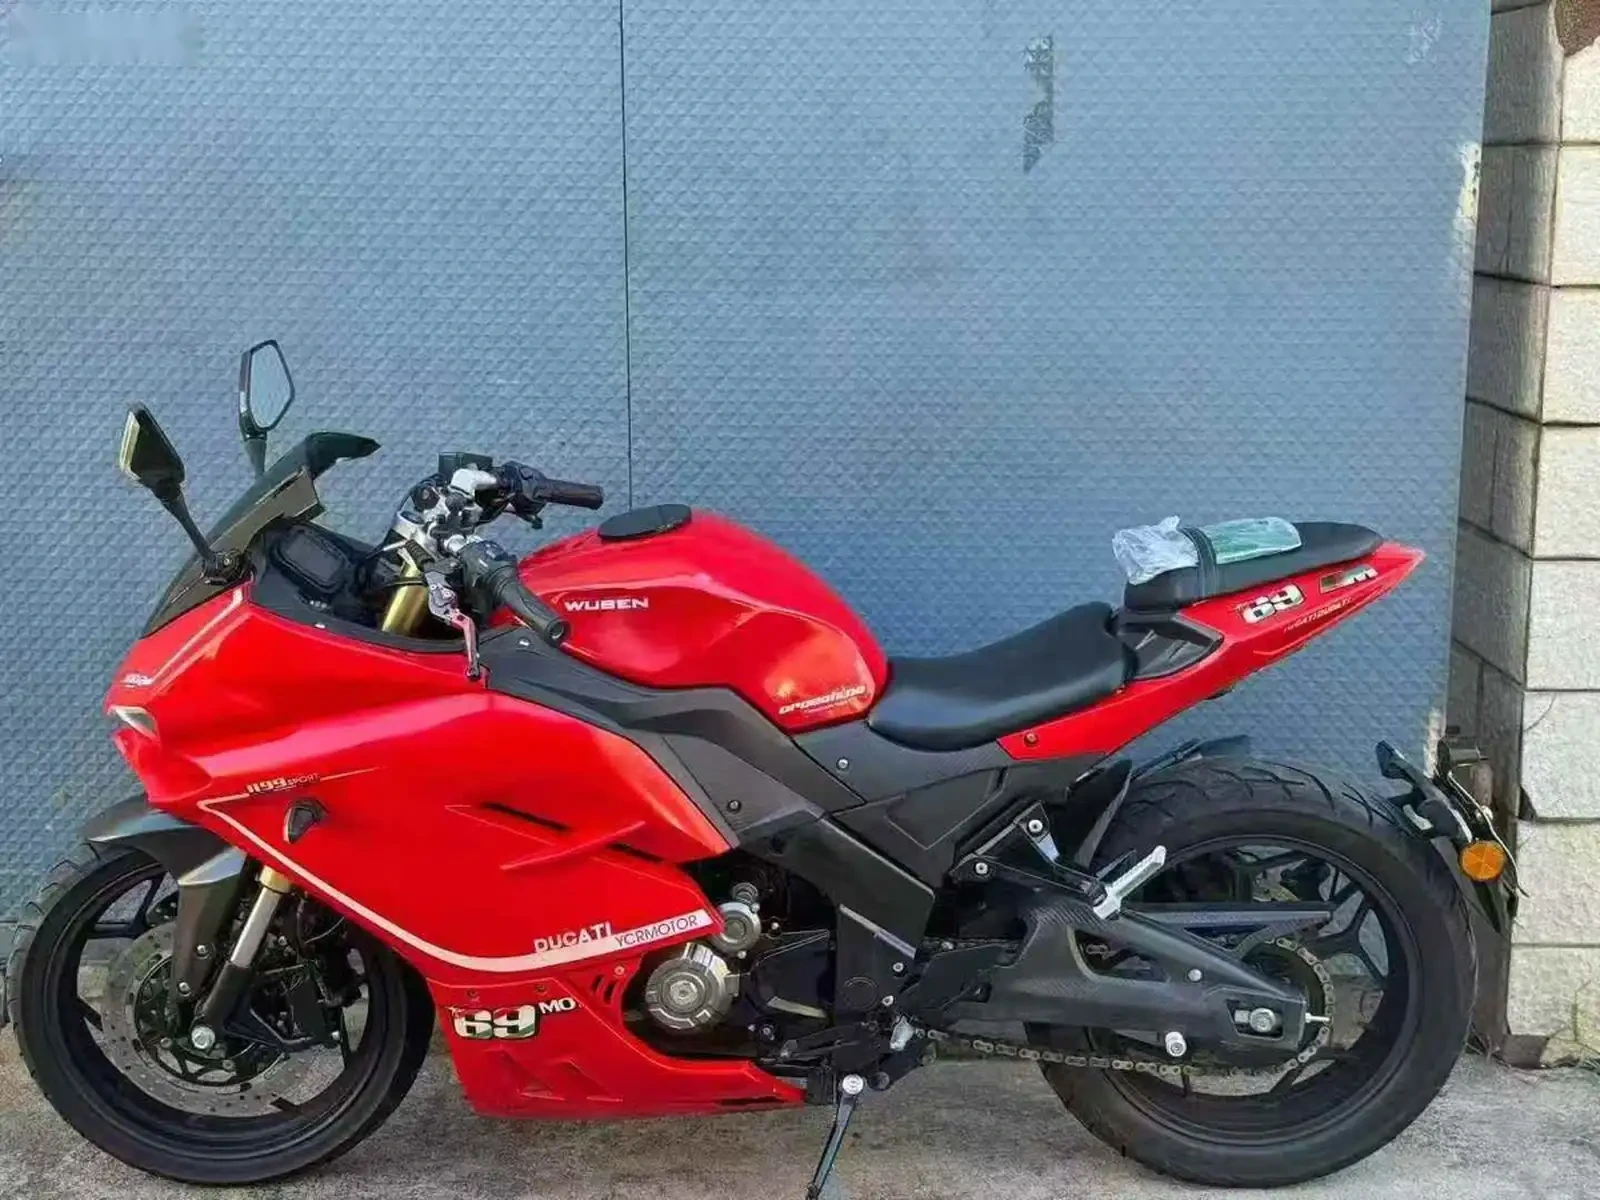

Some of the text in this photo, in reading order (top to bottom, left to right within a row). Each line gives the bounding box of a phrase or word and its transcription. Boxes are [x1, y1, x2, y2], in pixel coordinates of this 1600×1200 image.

[564, 597, 649, 612] WUBEN
[532, 921, 612, 952] DUCATI
[614, 914, 698, 947] YCRMOTOR
[452, 1003, 537, 1040] 69
